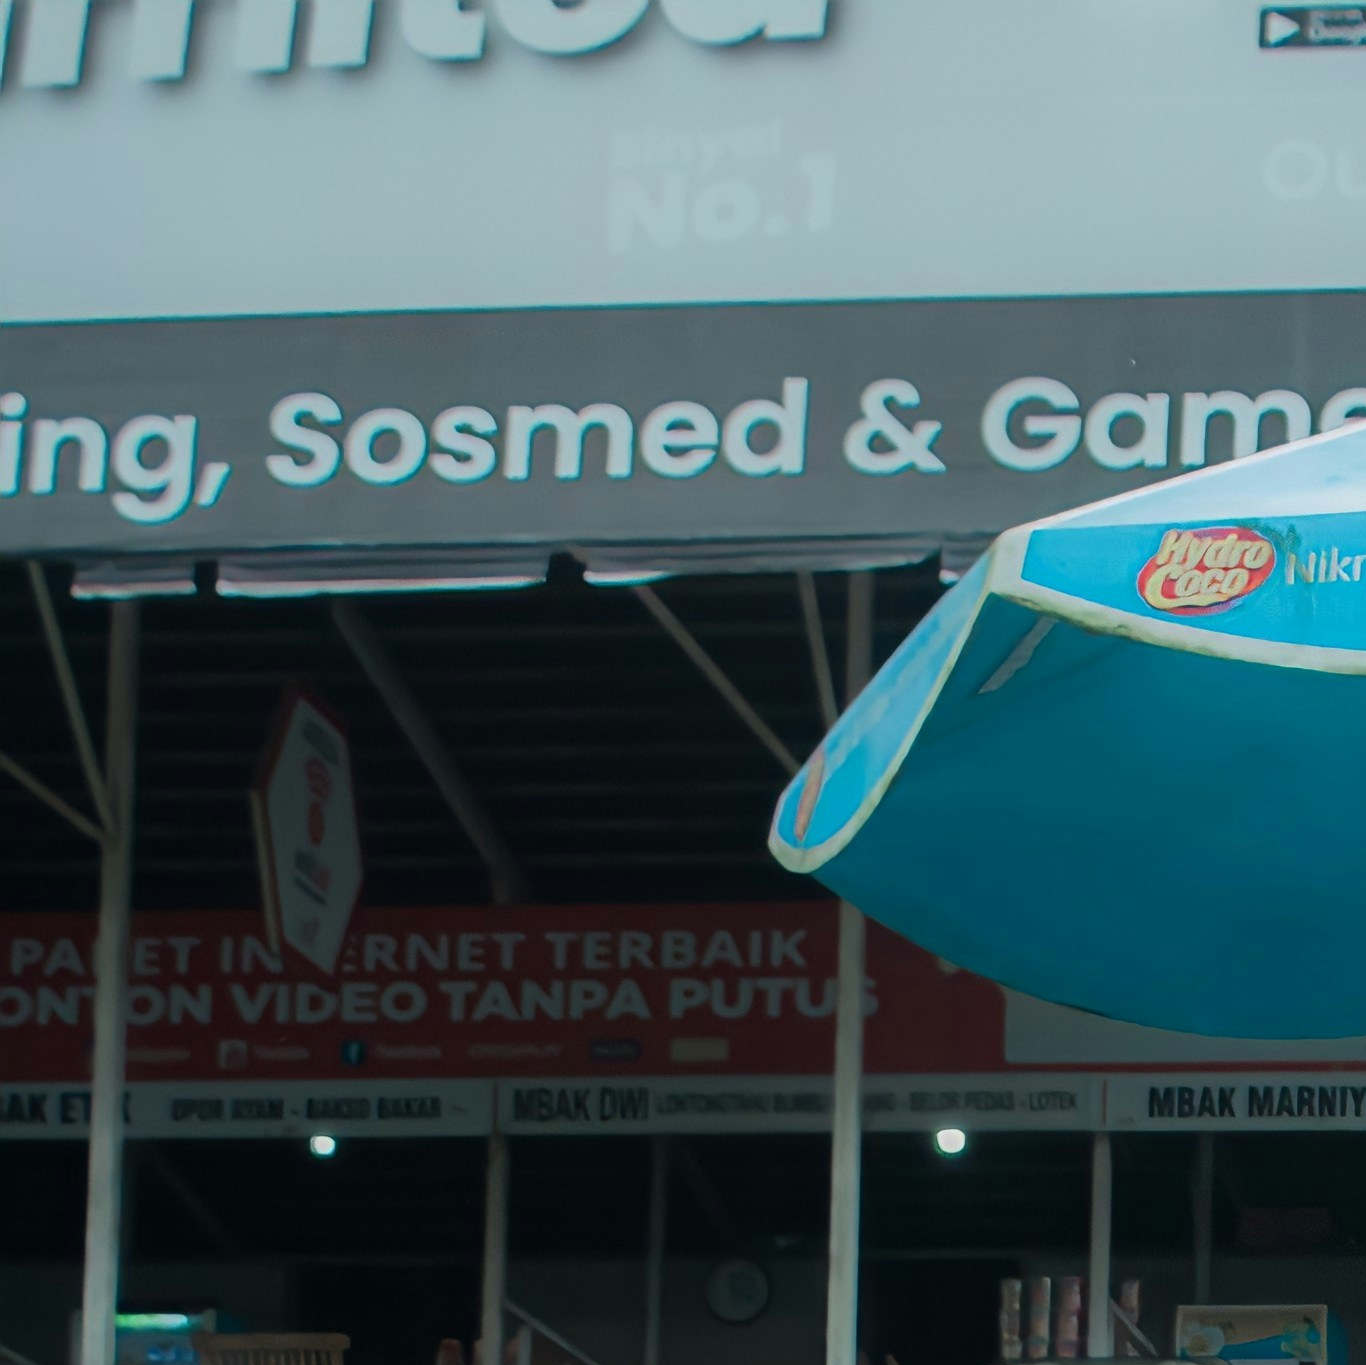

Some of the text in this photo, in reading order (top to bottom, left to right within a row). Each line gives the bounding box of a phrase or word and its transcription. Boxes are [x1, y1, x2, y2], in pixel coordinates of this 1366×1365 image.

[606, 150, 836, 253] No.1
[265, 376, 809, 489] Sosmed
[843, 378, 948, 477] &
[1156, 529, 1273, 571] Hydro
[1145, 564, 1251, 610] Coco
[10, 935, 201, 977] PAET
[545, 929, 808, 972] TERBAIK
[228, 980, 428, 1025] VIDEO
[438, 978, 652, 1022] TANPA
[513, 1086, 591, 1122] MBAK
[1148, 1086, 1236, 1118] MBAK
